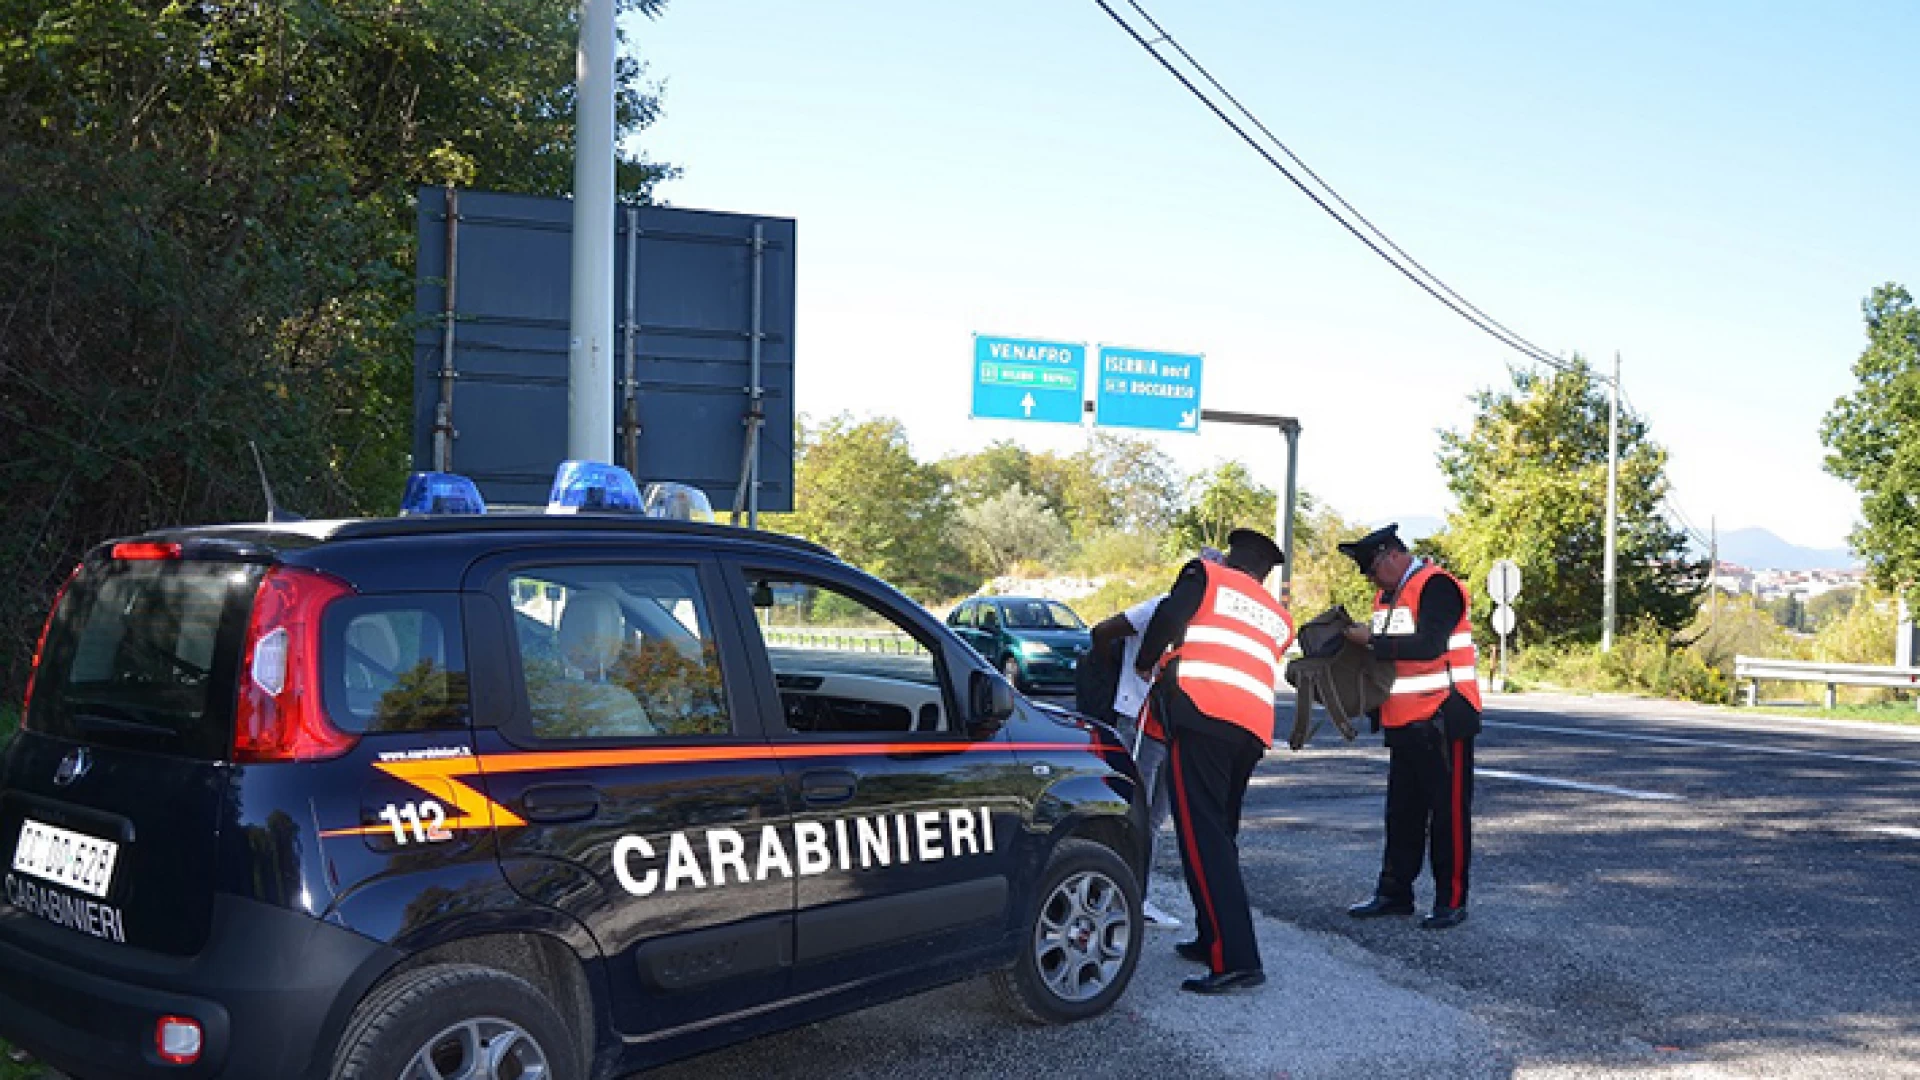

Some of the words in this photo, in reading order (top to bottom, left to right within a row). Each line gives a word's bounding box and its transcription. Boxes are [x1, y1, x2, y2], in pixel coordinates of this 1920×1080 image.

[989, 343, 1072, 364] VENAFRO
[378, 800, 452, 845] 112
[612, 806, 994, 896] CARABINIERI
[5, 873, 126, 942] CARABINIERI
